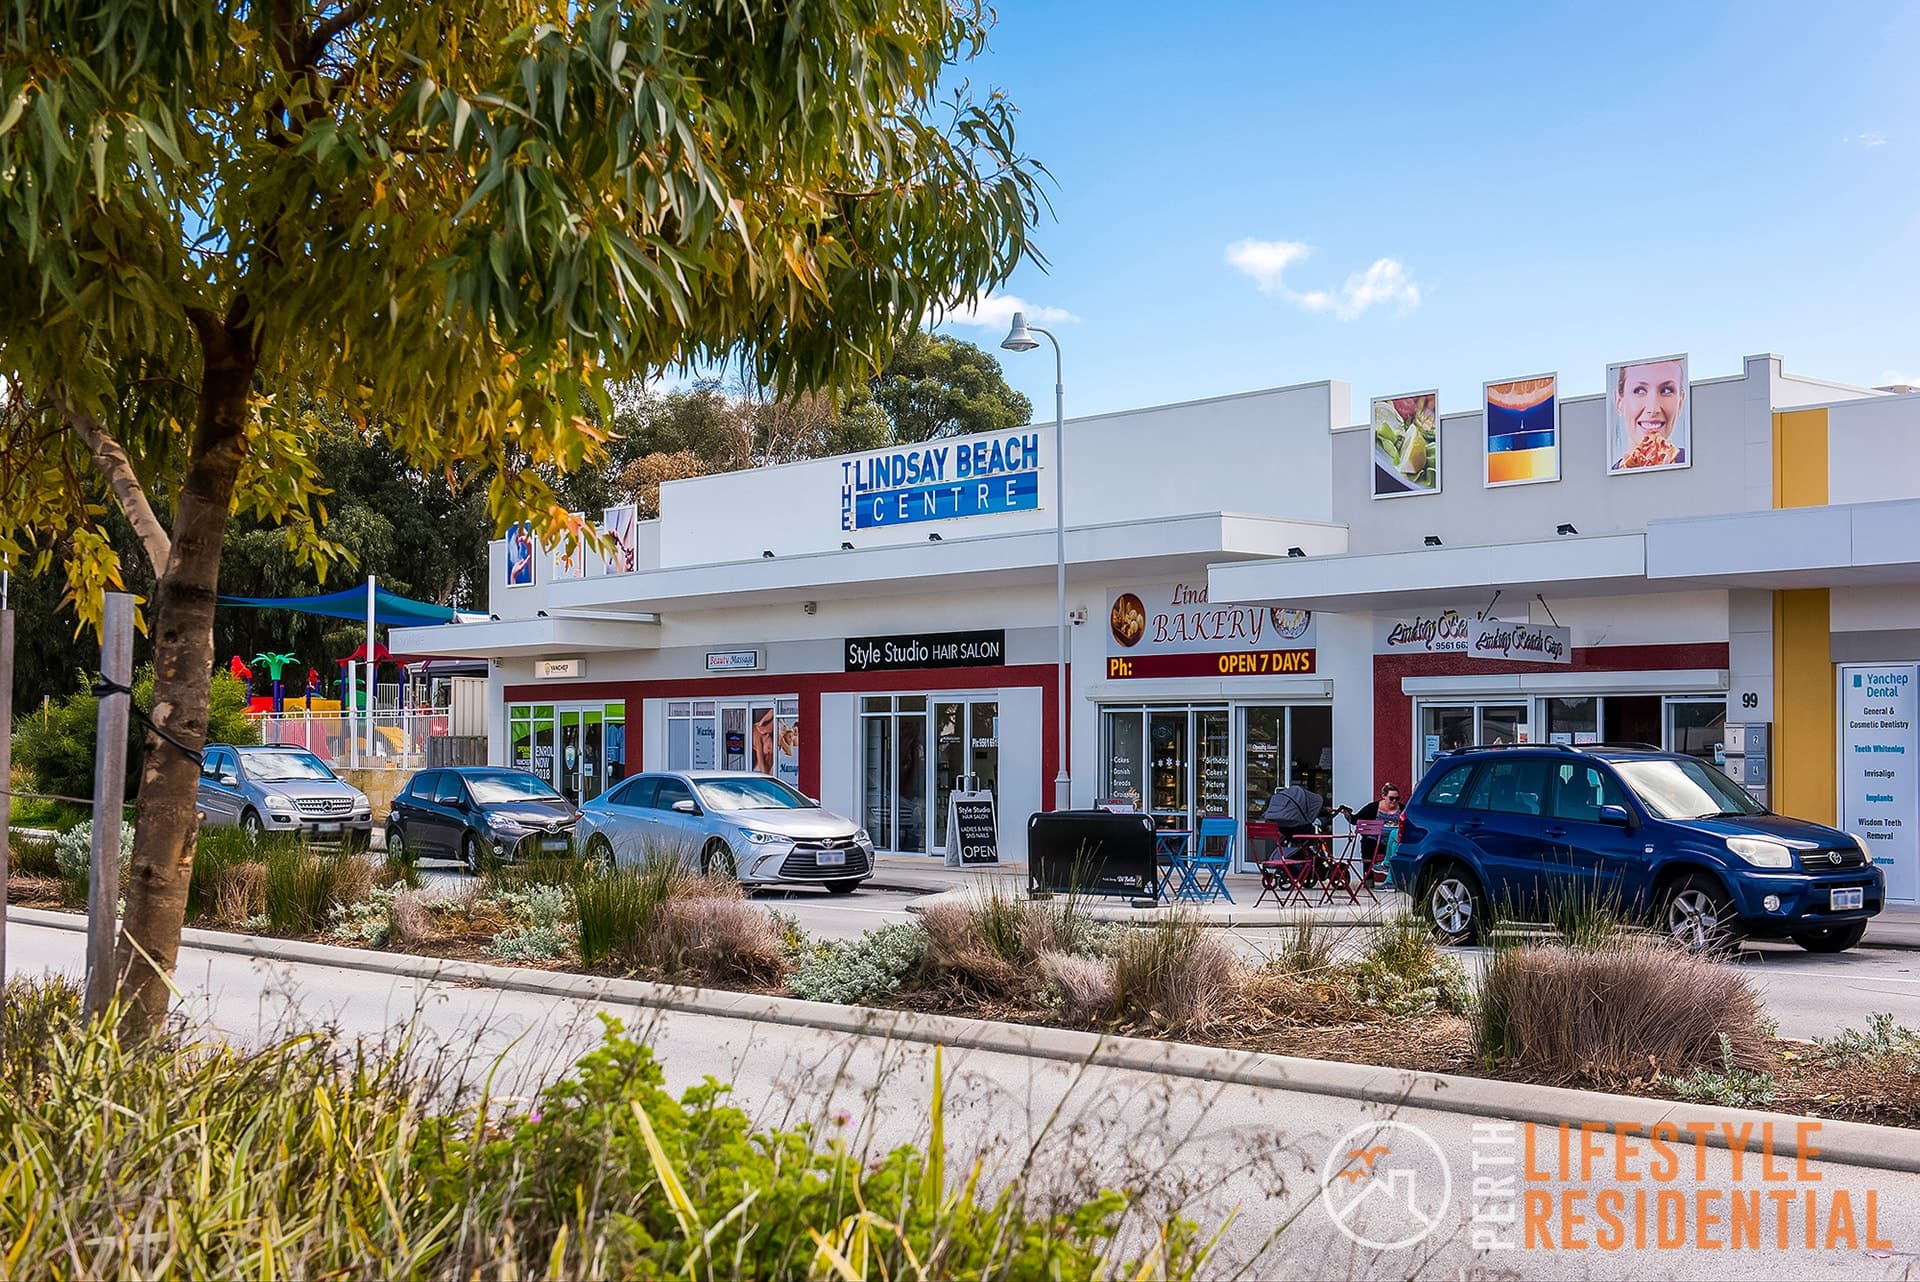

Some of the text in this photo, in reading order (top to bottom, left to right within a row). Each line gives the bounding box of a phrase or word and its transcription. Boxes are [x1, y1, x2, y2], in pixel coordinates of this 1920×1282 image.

[855, 433, 1039, 492] LINDSAY BEACH
[841, 461, 851, 531] THE
[872, 480, 1017, 522] CENTRE
[1152, 608, 1264, 645] BAKERY
[1435, 641, 1454, 650] 9561
[849, 639, 1000, 669] Style Studio HAIR SALON
[1110, 652, 1310, 677] Ph: OPEN 7 DAYS
[1867, 673, 1909, 686] Yanchep
[1867, 686, 1898, 698] Dental
[1741, 692, 1759, 708] 99
[1863, 706, 1895, 715] General &
[1849, 720, 1909, 730] Cosmetic Dentistry
[536, 745, 554, 757] ENROL
[1854, 744, 1905, 755] Teeth Whitening
[1113, 756, 1130, 764] Cakes
[1205, 768, 1223, 776] Cakes
[1864, 769, 1895, 779] Invisalign
[1113, 779, 1131, 787] Breads
[1865, 794, 1894, 803] Implants
[958, 806, 991, 815] Style Studio
[1205, 803, 1223, 812] Cakes
[1858, 818, 1902, 827] Wisdom Teeth
[1866, 831, 1894, 840] Removal
[963, 845, 996, 859] OPEN
